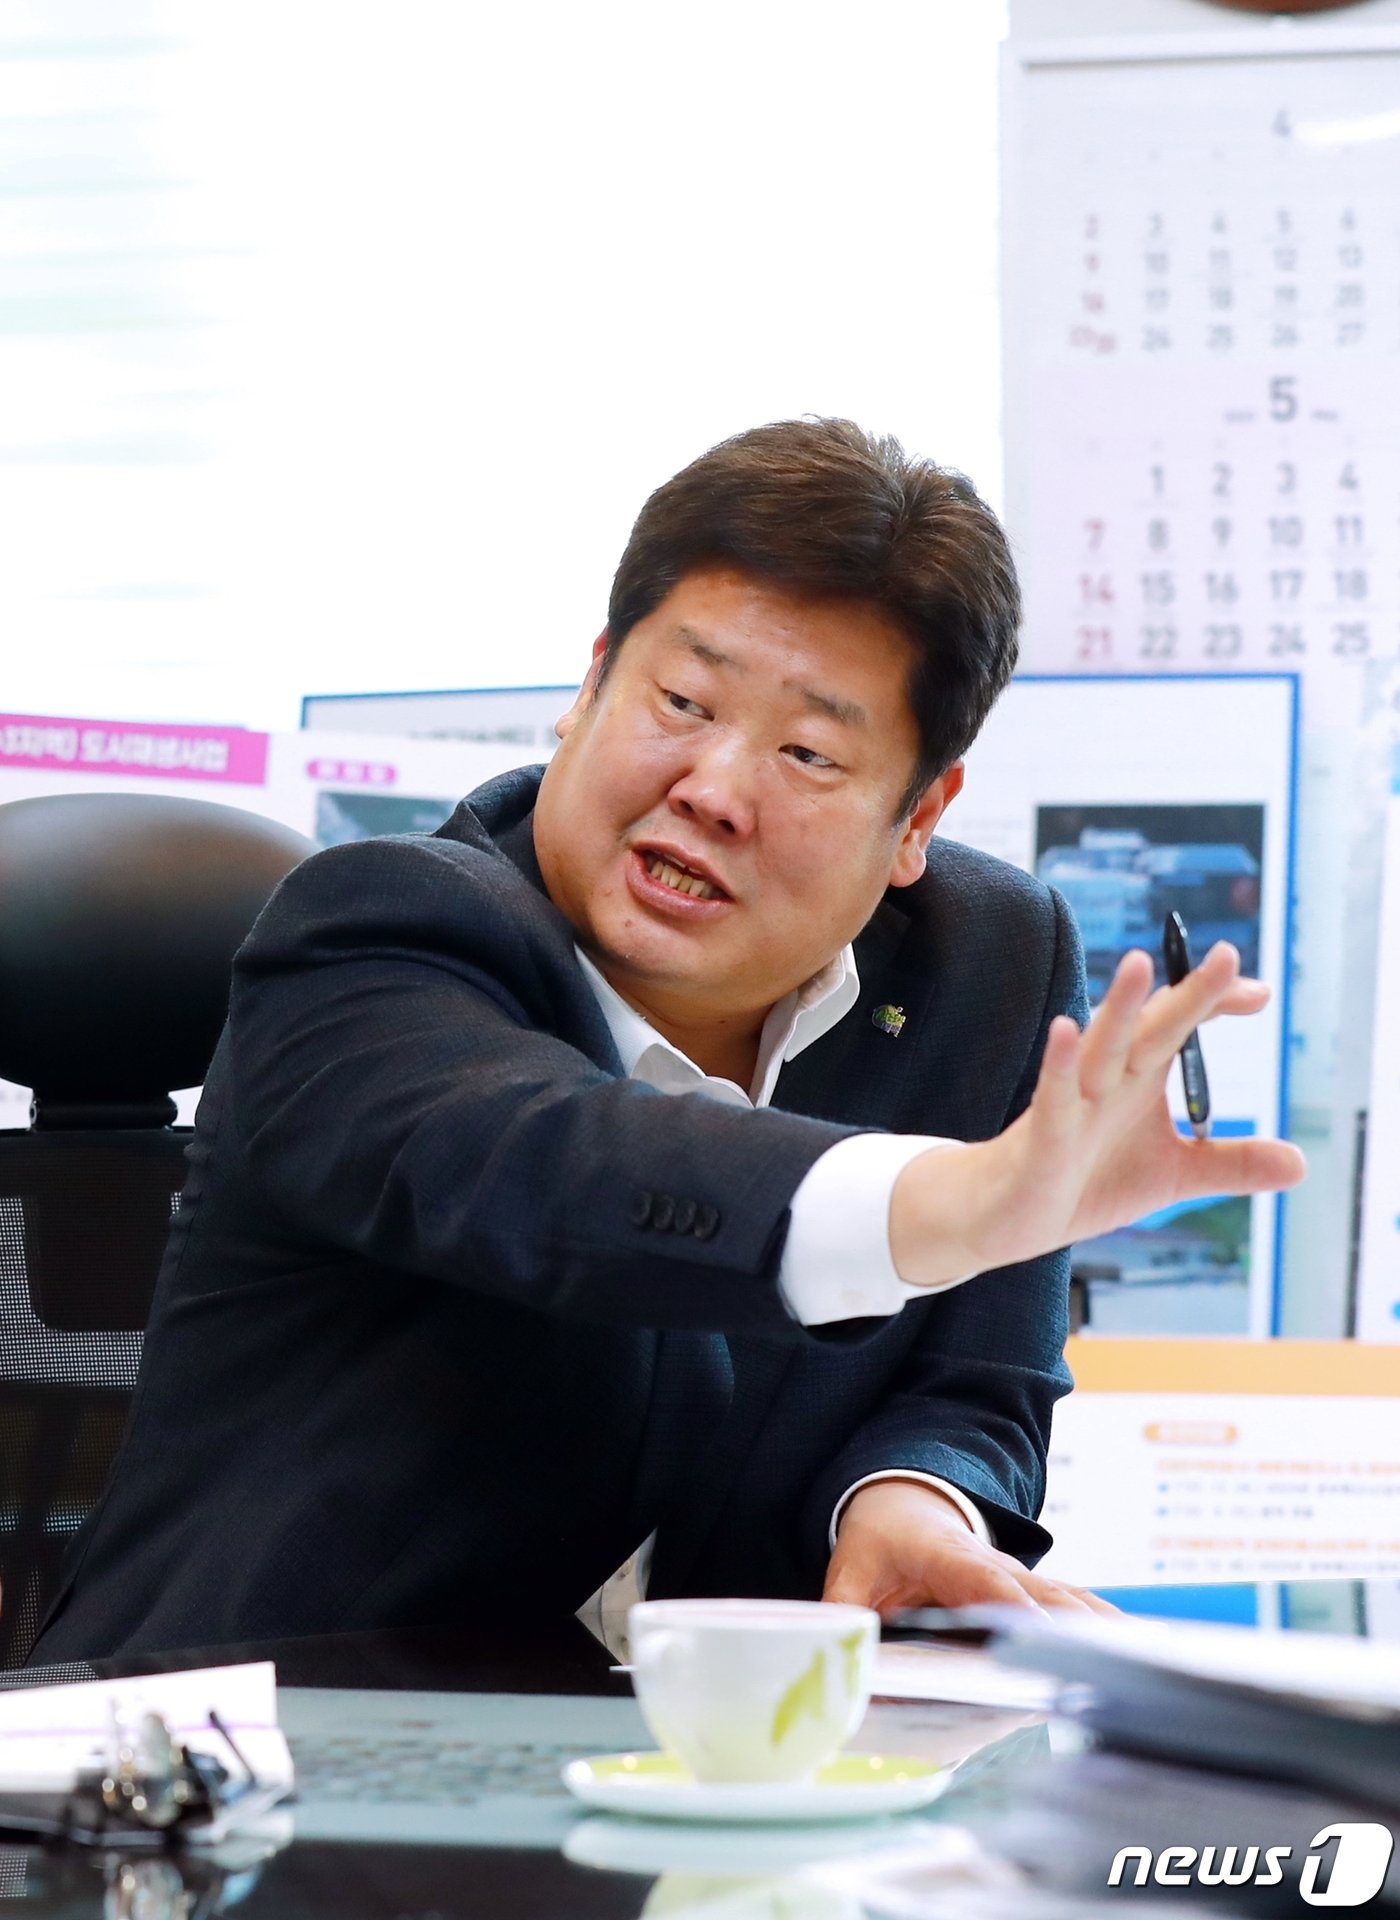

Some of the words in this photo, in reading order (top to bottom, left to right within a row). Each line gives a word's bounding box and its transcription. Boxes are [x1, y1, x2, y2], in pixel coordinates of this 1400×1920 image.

[1269, 376, 1298, 423] 5
[1150, 464, 1165, 496] 1
[1212, 462, 1233, 499] 2
[1277, 460, 1297, 496] 3
[1338, 462, 1359, 491] 4
[1083, 518, 1106, 553] 7
[1148, 519, 1169, 552] 8
[1212, 517, 1232, 547] 9
[1267, 515, 1304, 550] 10
[1333, 514, 1363, 547] 11
[1079, 574, 1115, 606] 14
[1139, 570, 1176, 607] 15
[1204, 571, 1239, 606] 16
[1269, 568, 1305, 601] 17
[1333, 568, 1368, 601] 18
[1076, 626, 1113, 660] 21
[1139, 625, 1178, 660] 22
[1203, 624, 1243, 660] 23
[1267, 624, 1306, 658] 24
[1332, 621, 1370, 657] 25
